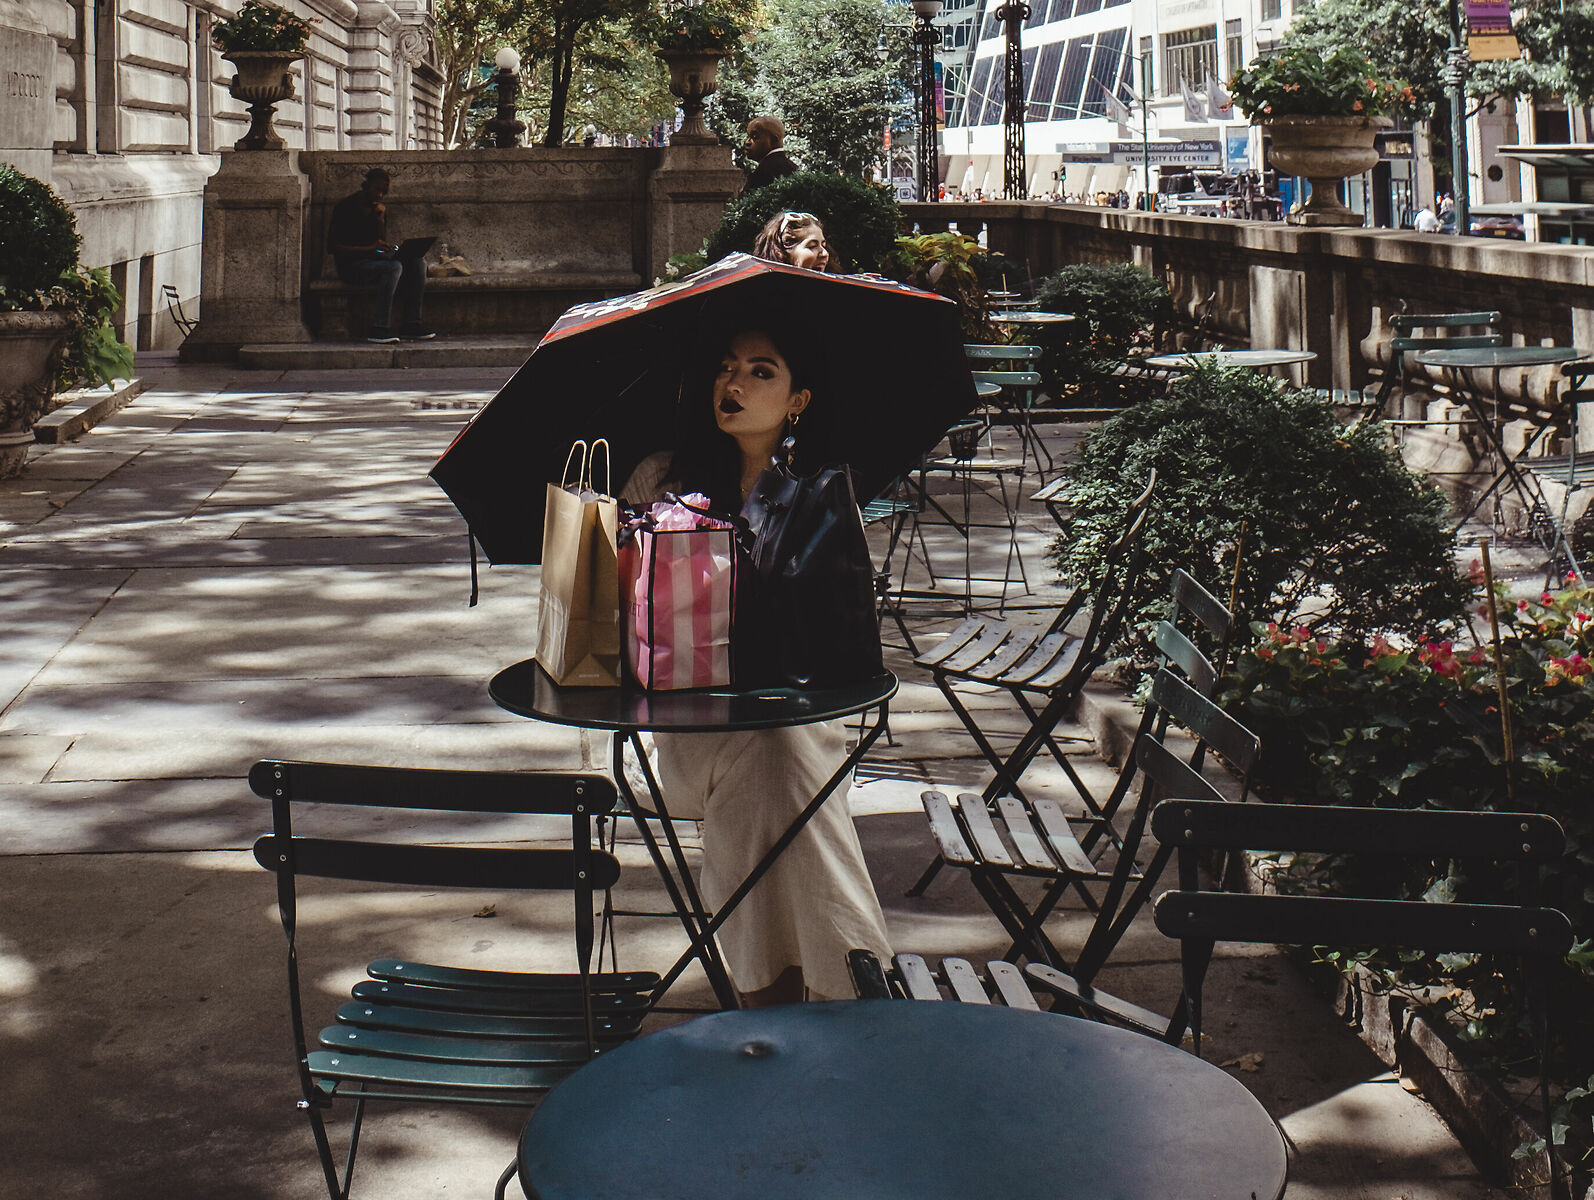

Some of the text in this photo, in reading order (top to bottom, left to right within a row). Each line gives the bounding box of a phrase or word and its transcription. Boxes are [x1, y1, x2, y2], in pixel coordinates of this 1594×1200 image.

[1118, 143, 1130, 151] The
[1147, 143, 1177, 152] University
[1184, 143, 1200, 151] New
[1200, 142, 1214, 151] York
